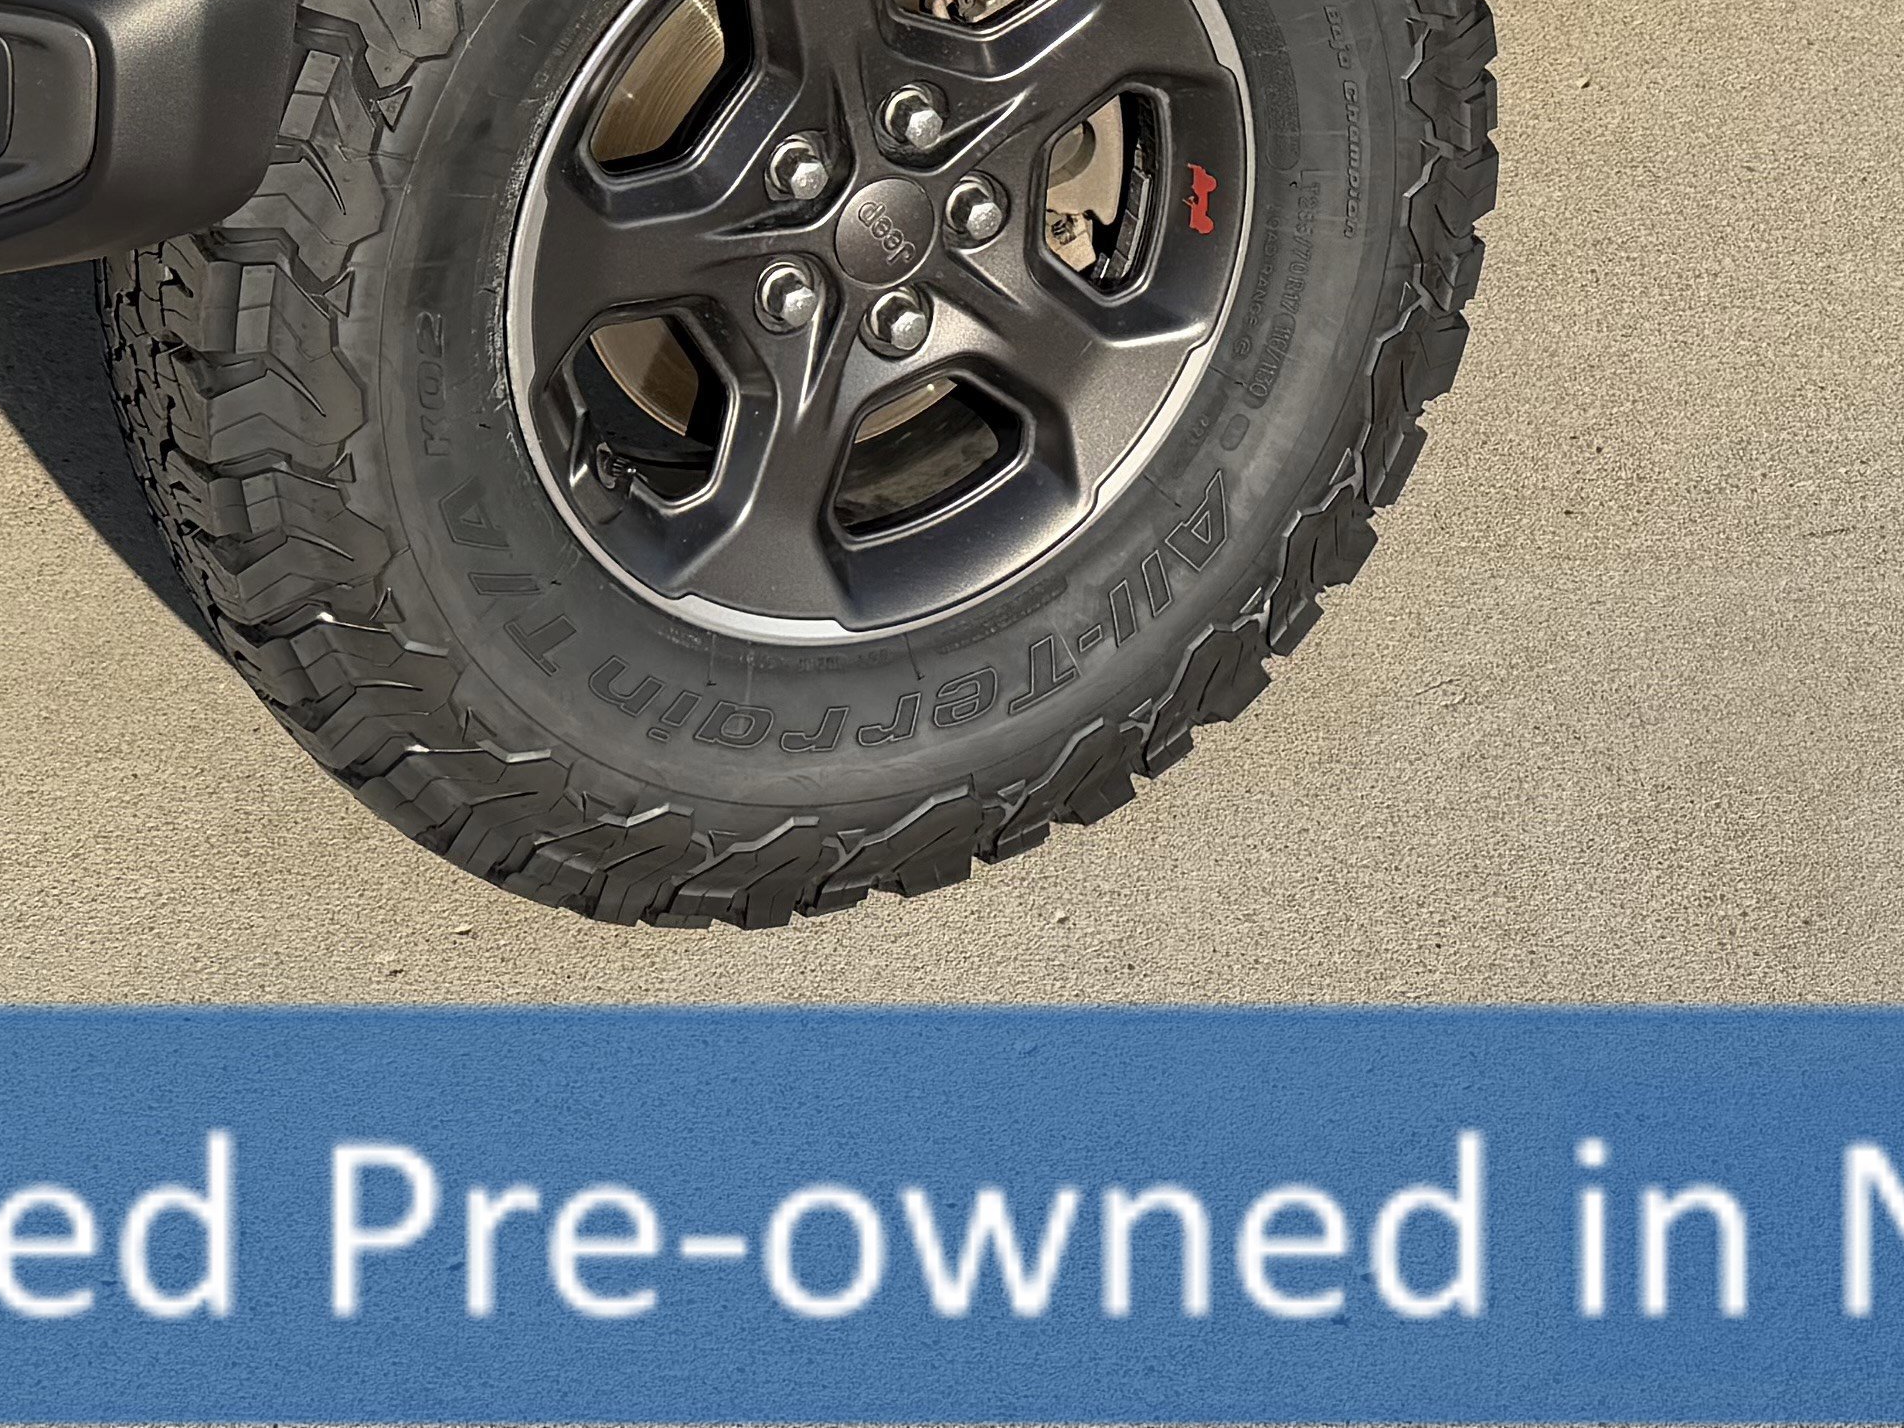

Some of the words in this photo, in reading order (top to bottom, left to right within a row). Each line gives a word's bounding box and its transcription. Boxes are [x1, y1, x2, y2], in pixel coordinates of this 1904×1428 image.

[857, 201, 916, 265] Jeep
[1323, 5, 1351, 70] Baja
[1342, 79, 1362, 240] Champion
[585, 468, 1230, 757] All-Terrain
